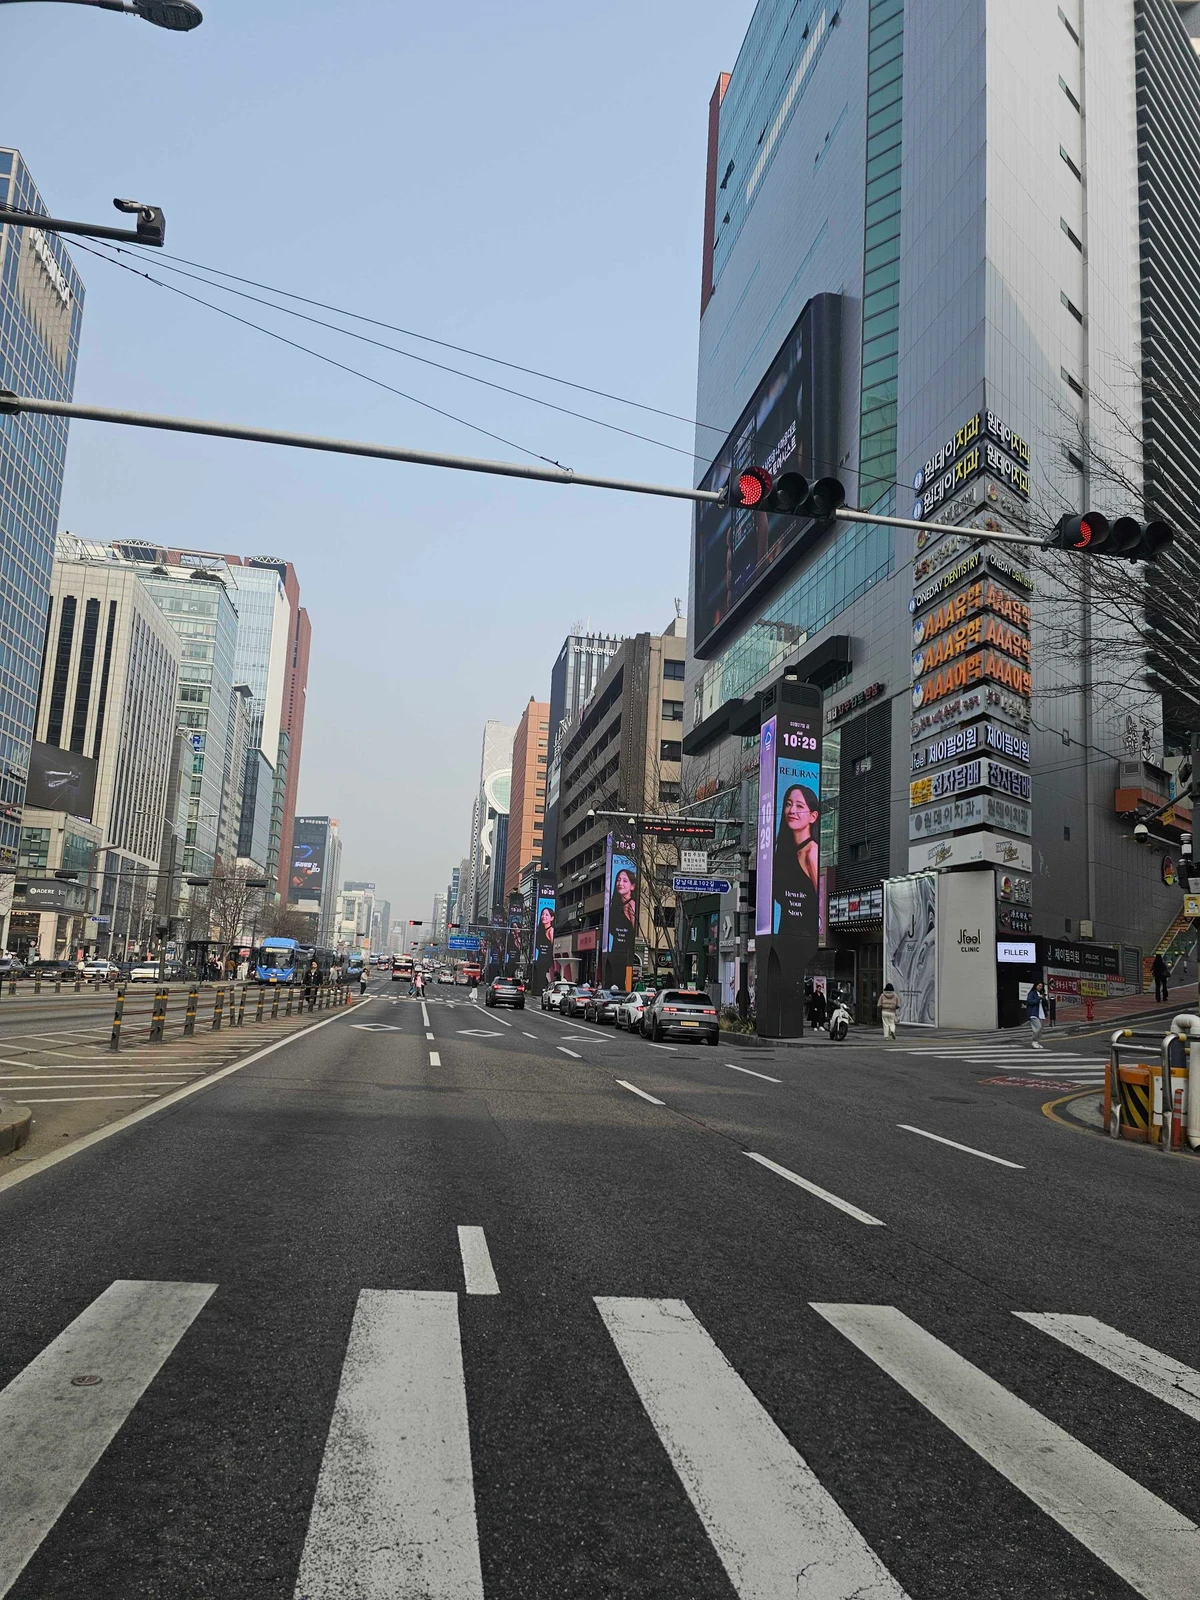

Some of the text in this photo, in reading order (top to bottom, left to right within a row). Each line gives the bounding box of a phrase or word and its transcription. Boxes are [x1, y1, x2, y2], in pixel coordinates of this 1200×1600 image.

[923, 413, 981, 484] 원데이치과
[986, 410, 1031, 465] 원데이치과
[922, 446, 980, 514] 원데이치과
[986, 444, 1031, 497] 원데이치과
[916, 579, 943, 607] ONEDAY
[943, 554, 980, 588] DENTISTRY
[990, 554, 1012, 576] ONEDAY
[924, 582, 982, 642] AAA유학
[986, 584, 1032, 632] AAA유학
[923, 615, 982, 673] AAA유학
[985, 618, 1032, 664] AAA유학
[923, 653, 982, 705] AAA어학
[985, 653, 1033, 698] AAA어학
[783, 733, 817, 751] 10:29
[910, 727, 978, 771] Jfeel 제이필의원
[986, 725, 1030, 763] 제이필의원
[779, 767, 818, 779] REJURAN
[932, 761, 981, 797] 전자담배
[989, 762, 1031, 799] 전자담배
[761, 802, 771, 825] 10
[923, 799, 975, 828] 원데이치과
[987, 798, 1029, 828] 원데이치과
[760, 828, 771, 850] 29
[675, 878, 715, 887] 강남대로102길
[785, 890, 807, 899] Rewrite
[957, 929, 982, 945] Jfeel
[1004, 948, 1029, 957] FILLER
[1054, 947, 1080, 964] 제이필의원
